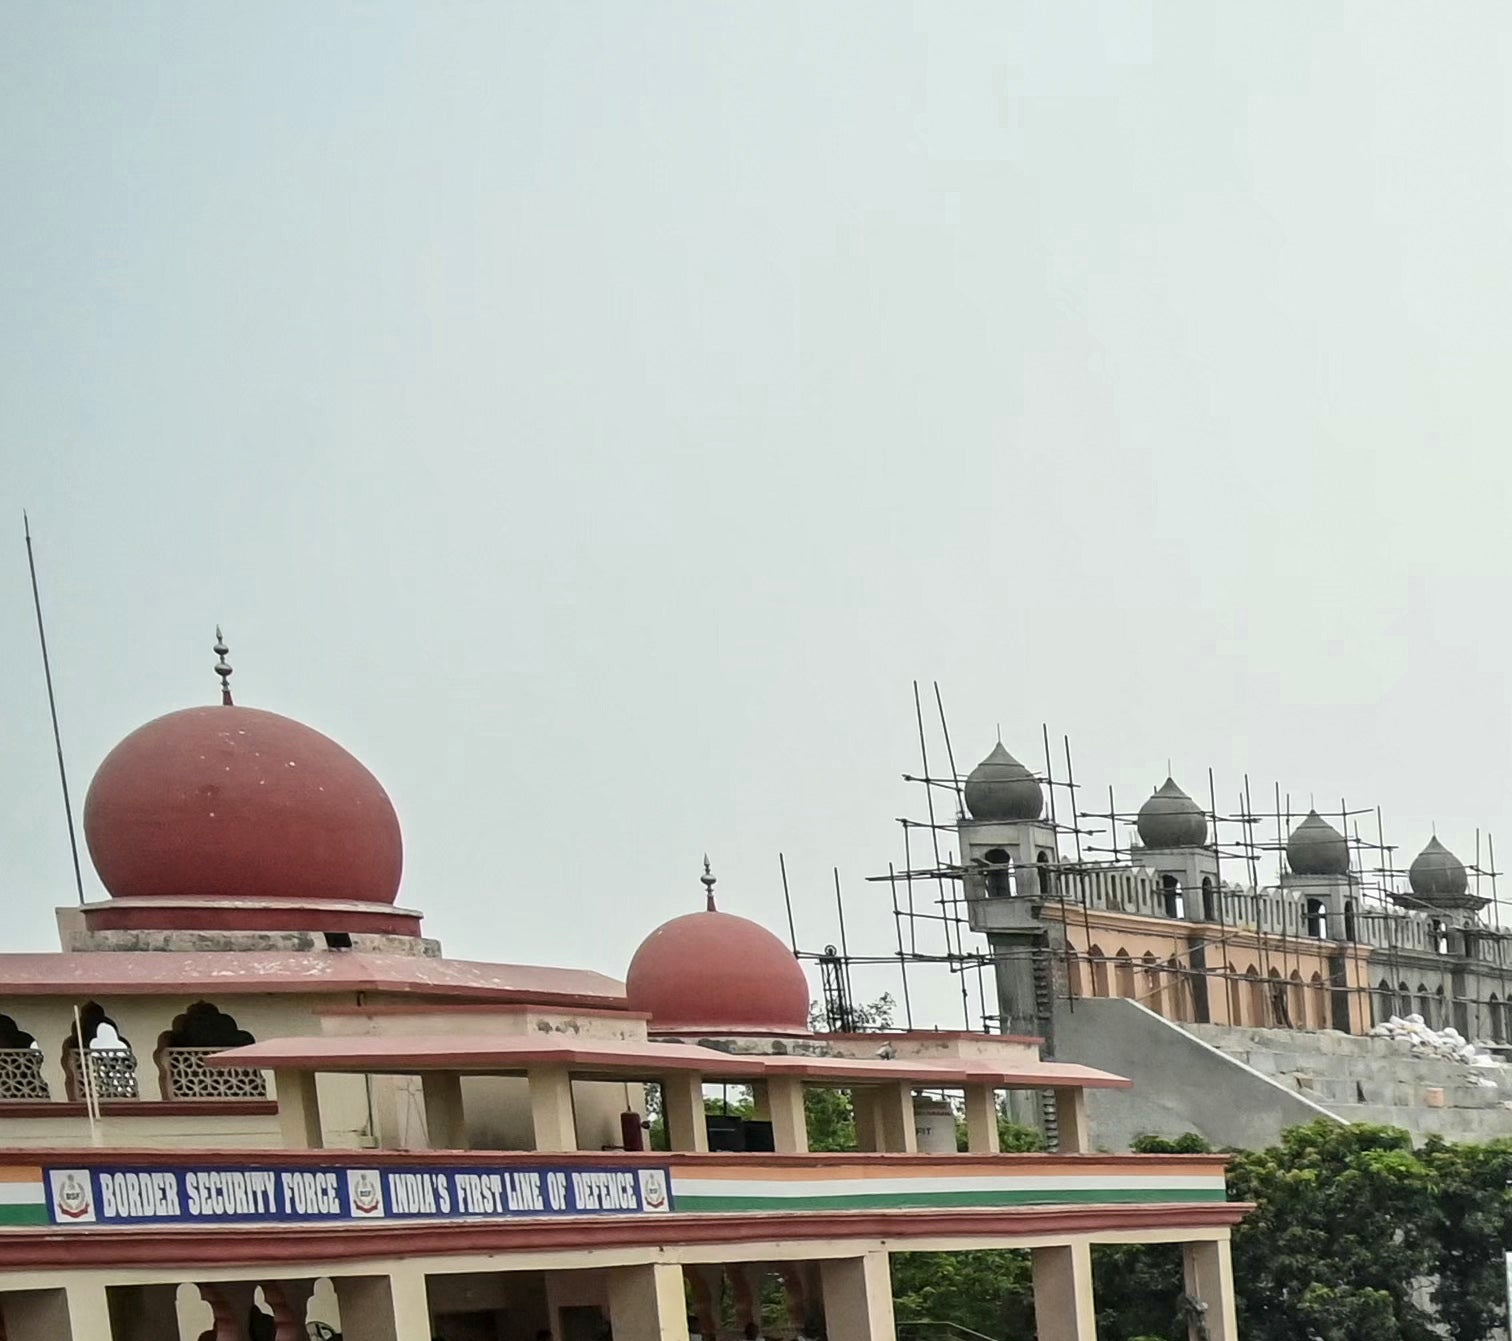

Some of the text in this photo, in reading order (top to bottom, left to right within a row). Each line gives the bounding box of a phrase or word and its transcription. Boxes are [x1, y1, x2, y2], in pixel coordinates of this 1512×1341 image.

[99, 1171, 341, 1218] BORDER SECURITY FORCE
[388, 1171, 638, 1214] INDIA'S FIRST LINE OF DEFENCE
